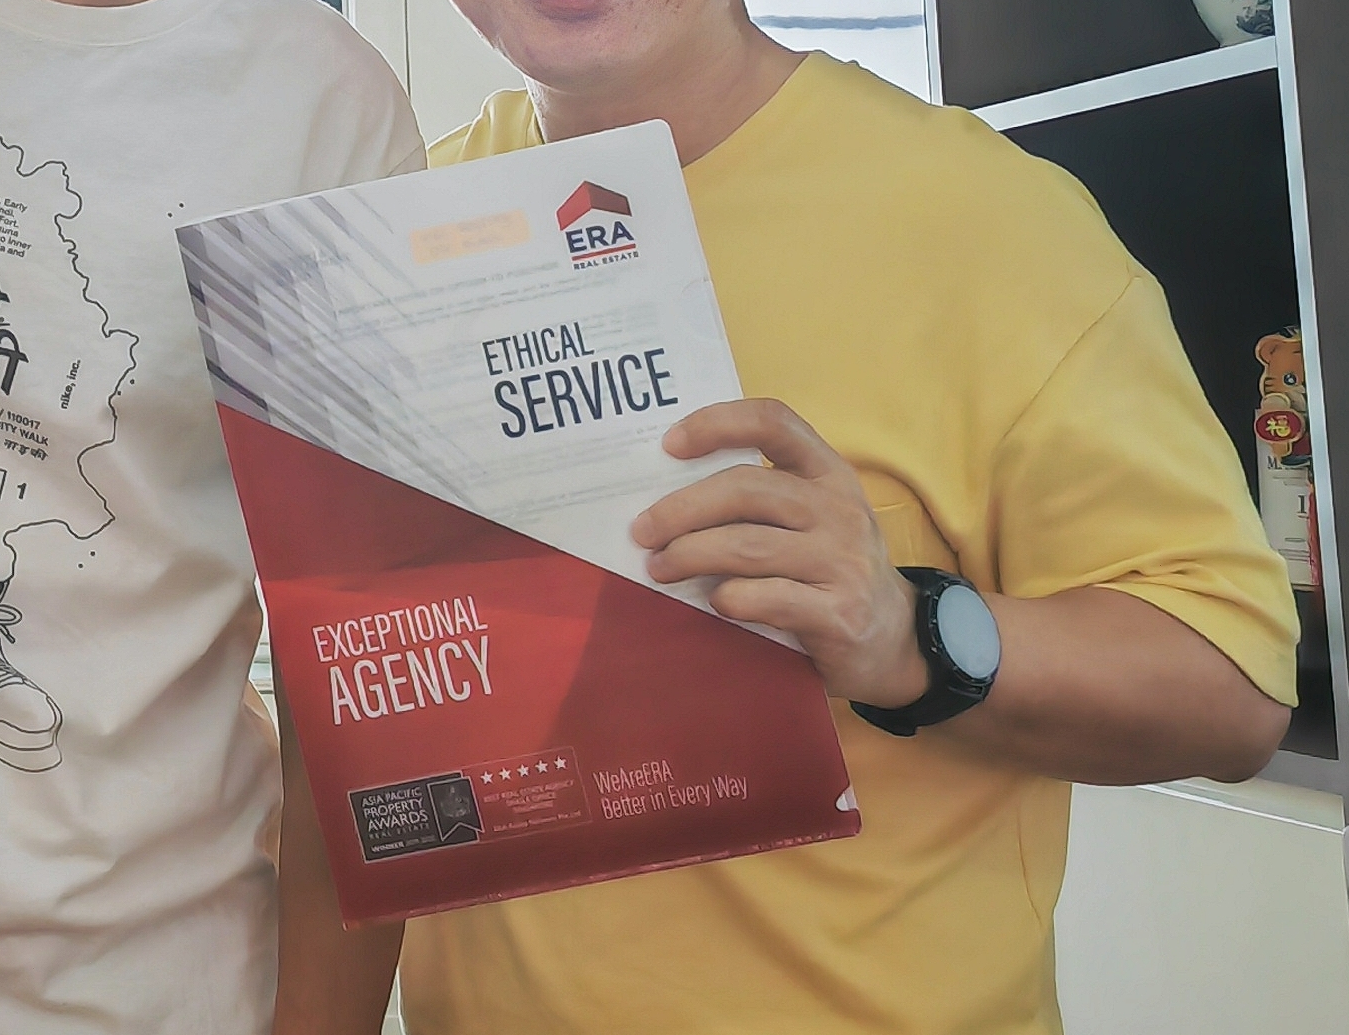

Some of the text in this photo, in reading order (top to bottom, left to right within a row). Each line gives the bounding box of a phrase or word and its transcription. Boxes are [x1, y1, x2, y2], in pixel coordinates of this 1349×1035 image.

[4, 199, 27, 212] Early
[8, 237, 32, 250] Inner
[566, 221, 634, 253] ERA
[7, 248, 25, 258] and
[573, 251, 639, 270] REAL ESTATE
[482, 322, 594, 375] ETHICAL
[61, 360, 81, 409] nike, inc.
[494, 348, 678, 438] SERVICE
[7, 411, 40, 430] 110017
[20, 429, 49, 446] WALK
[17, 483, 27, 499] 1
[312, 595, 488, 662] EXCEPTIONAL
[329, 635, 492, 725] AGENCY
[593, 760, 674, 794] WeAreERA
[362, 787, 422, 807] ASIA PACIFIC
[363, 797, 423, 818] PROPERTY
[601, 775, 747, 820] Better in Every Way
[368, 810, 428, 832] AWARDS
